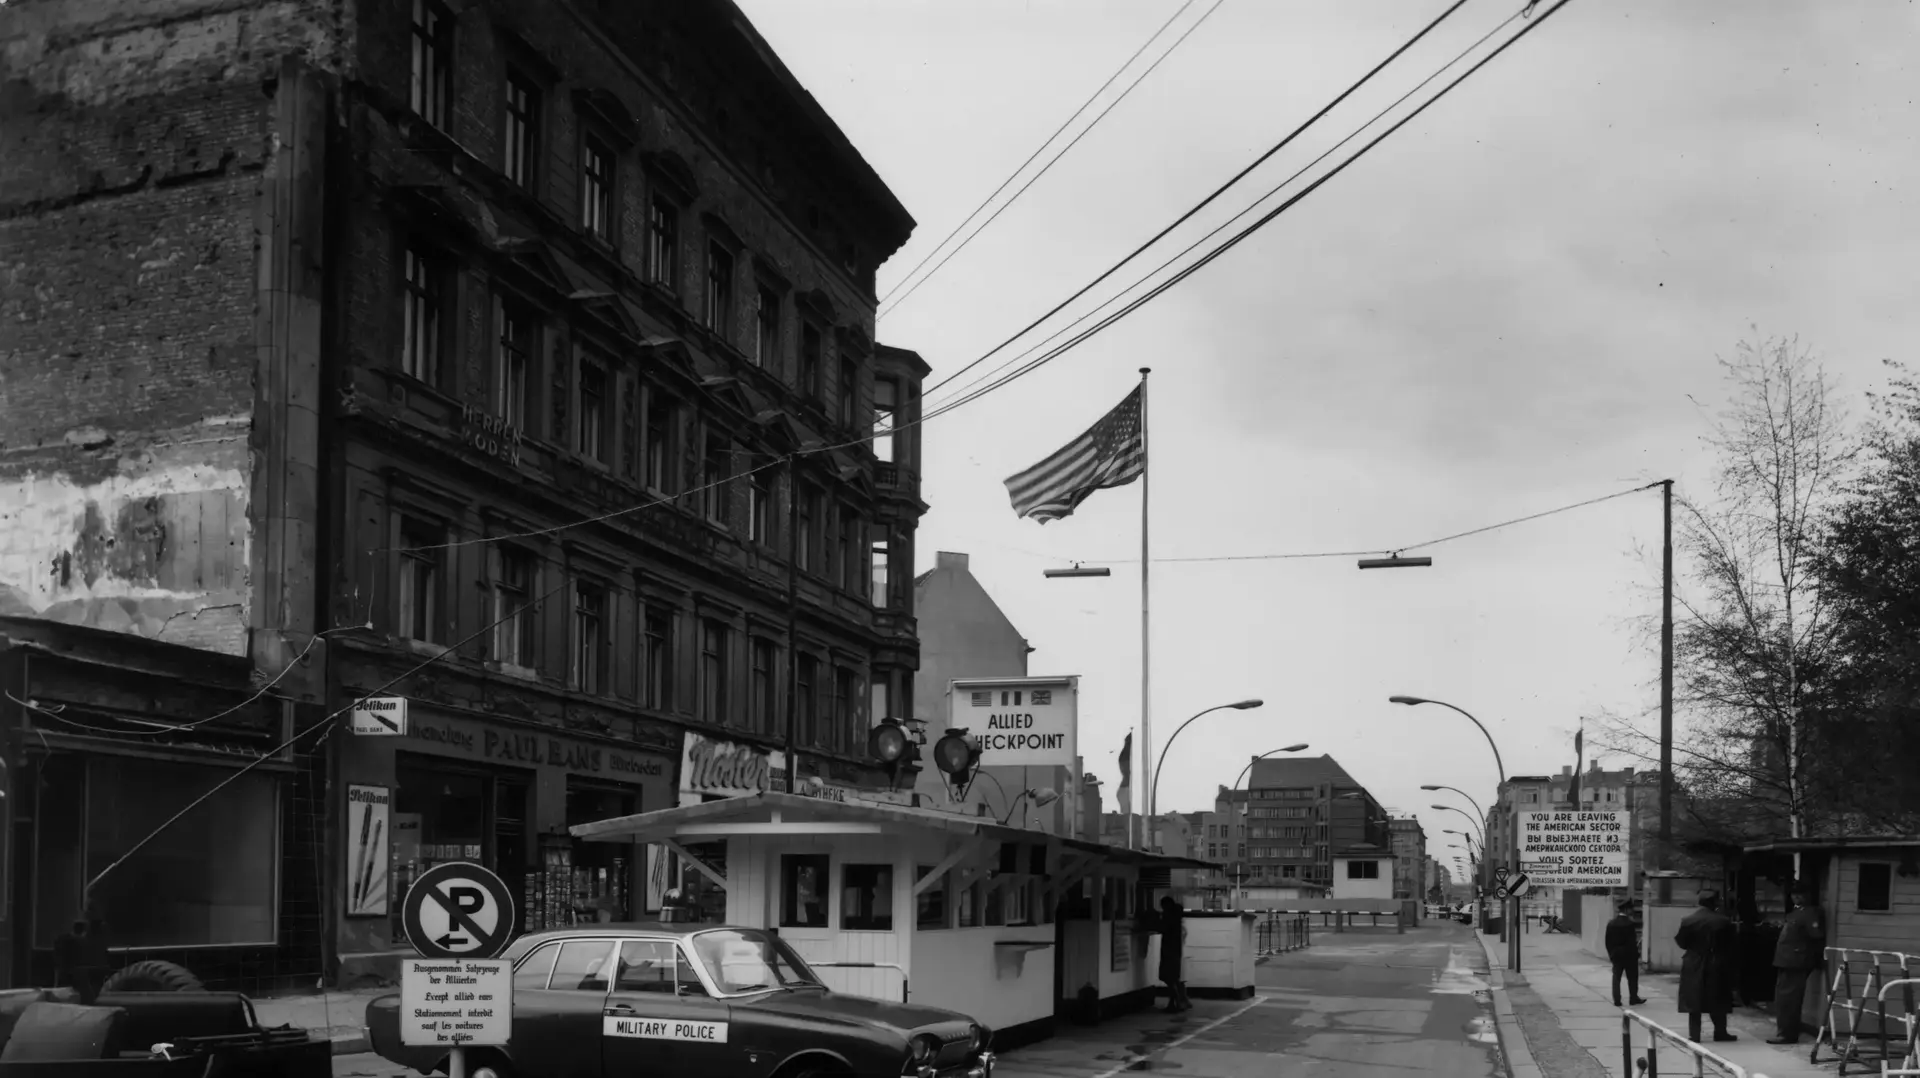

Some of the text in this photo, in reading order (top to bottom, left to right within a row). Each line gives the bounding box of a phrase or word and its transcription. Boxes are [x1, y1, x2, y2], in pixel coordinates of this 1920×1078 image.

[462, 402, 522, 446] HERREN
[356, 700, 397, 711] Pelikan
[988, 714, 1033, 729] ALLIED
[975, 734, 1065, 750] HECKPOINT
[1531, 813, 1616, 821] YOU ARE LEAVING
[1526, 823, 1621, 831] THE AMERICAN SECTOR
[1527, 835, 1619, 843] ВЫ ВЫЕЗЖАЕТЕ ИЗ
[1525, 845, 1621, 853] АМЕРИКАНСКОГО СЕКТОРА
[1569, 856, 1604, 864] SORTEZ
[1577, 866, 1622, 874] AMERICAIN
[413, 963, 461, 974] Ausgenommen
[429, 975, 441, 984] der
[425, 991, 449, 1004] Except
[454, 991, 475, 1000] allied
[414, 1008, 493, 1017] Stationnement interdit
[421, 1021, 484, 1031] sauf les voitures
[616, 1020, 715, 1040] MILITARY POLICE
